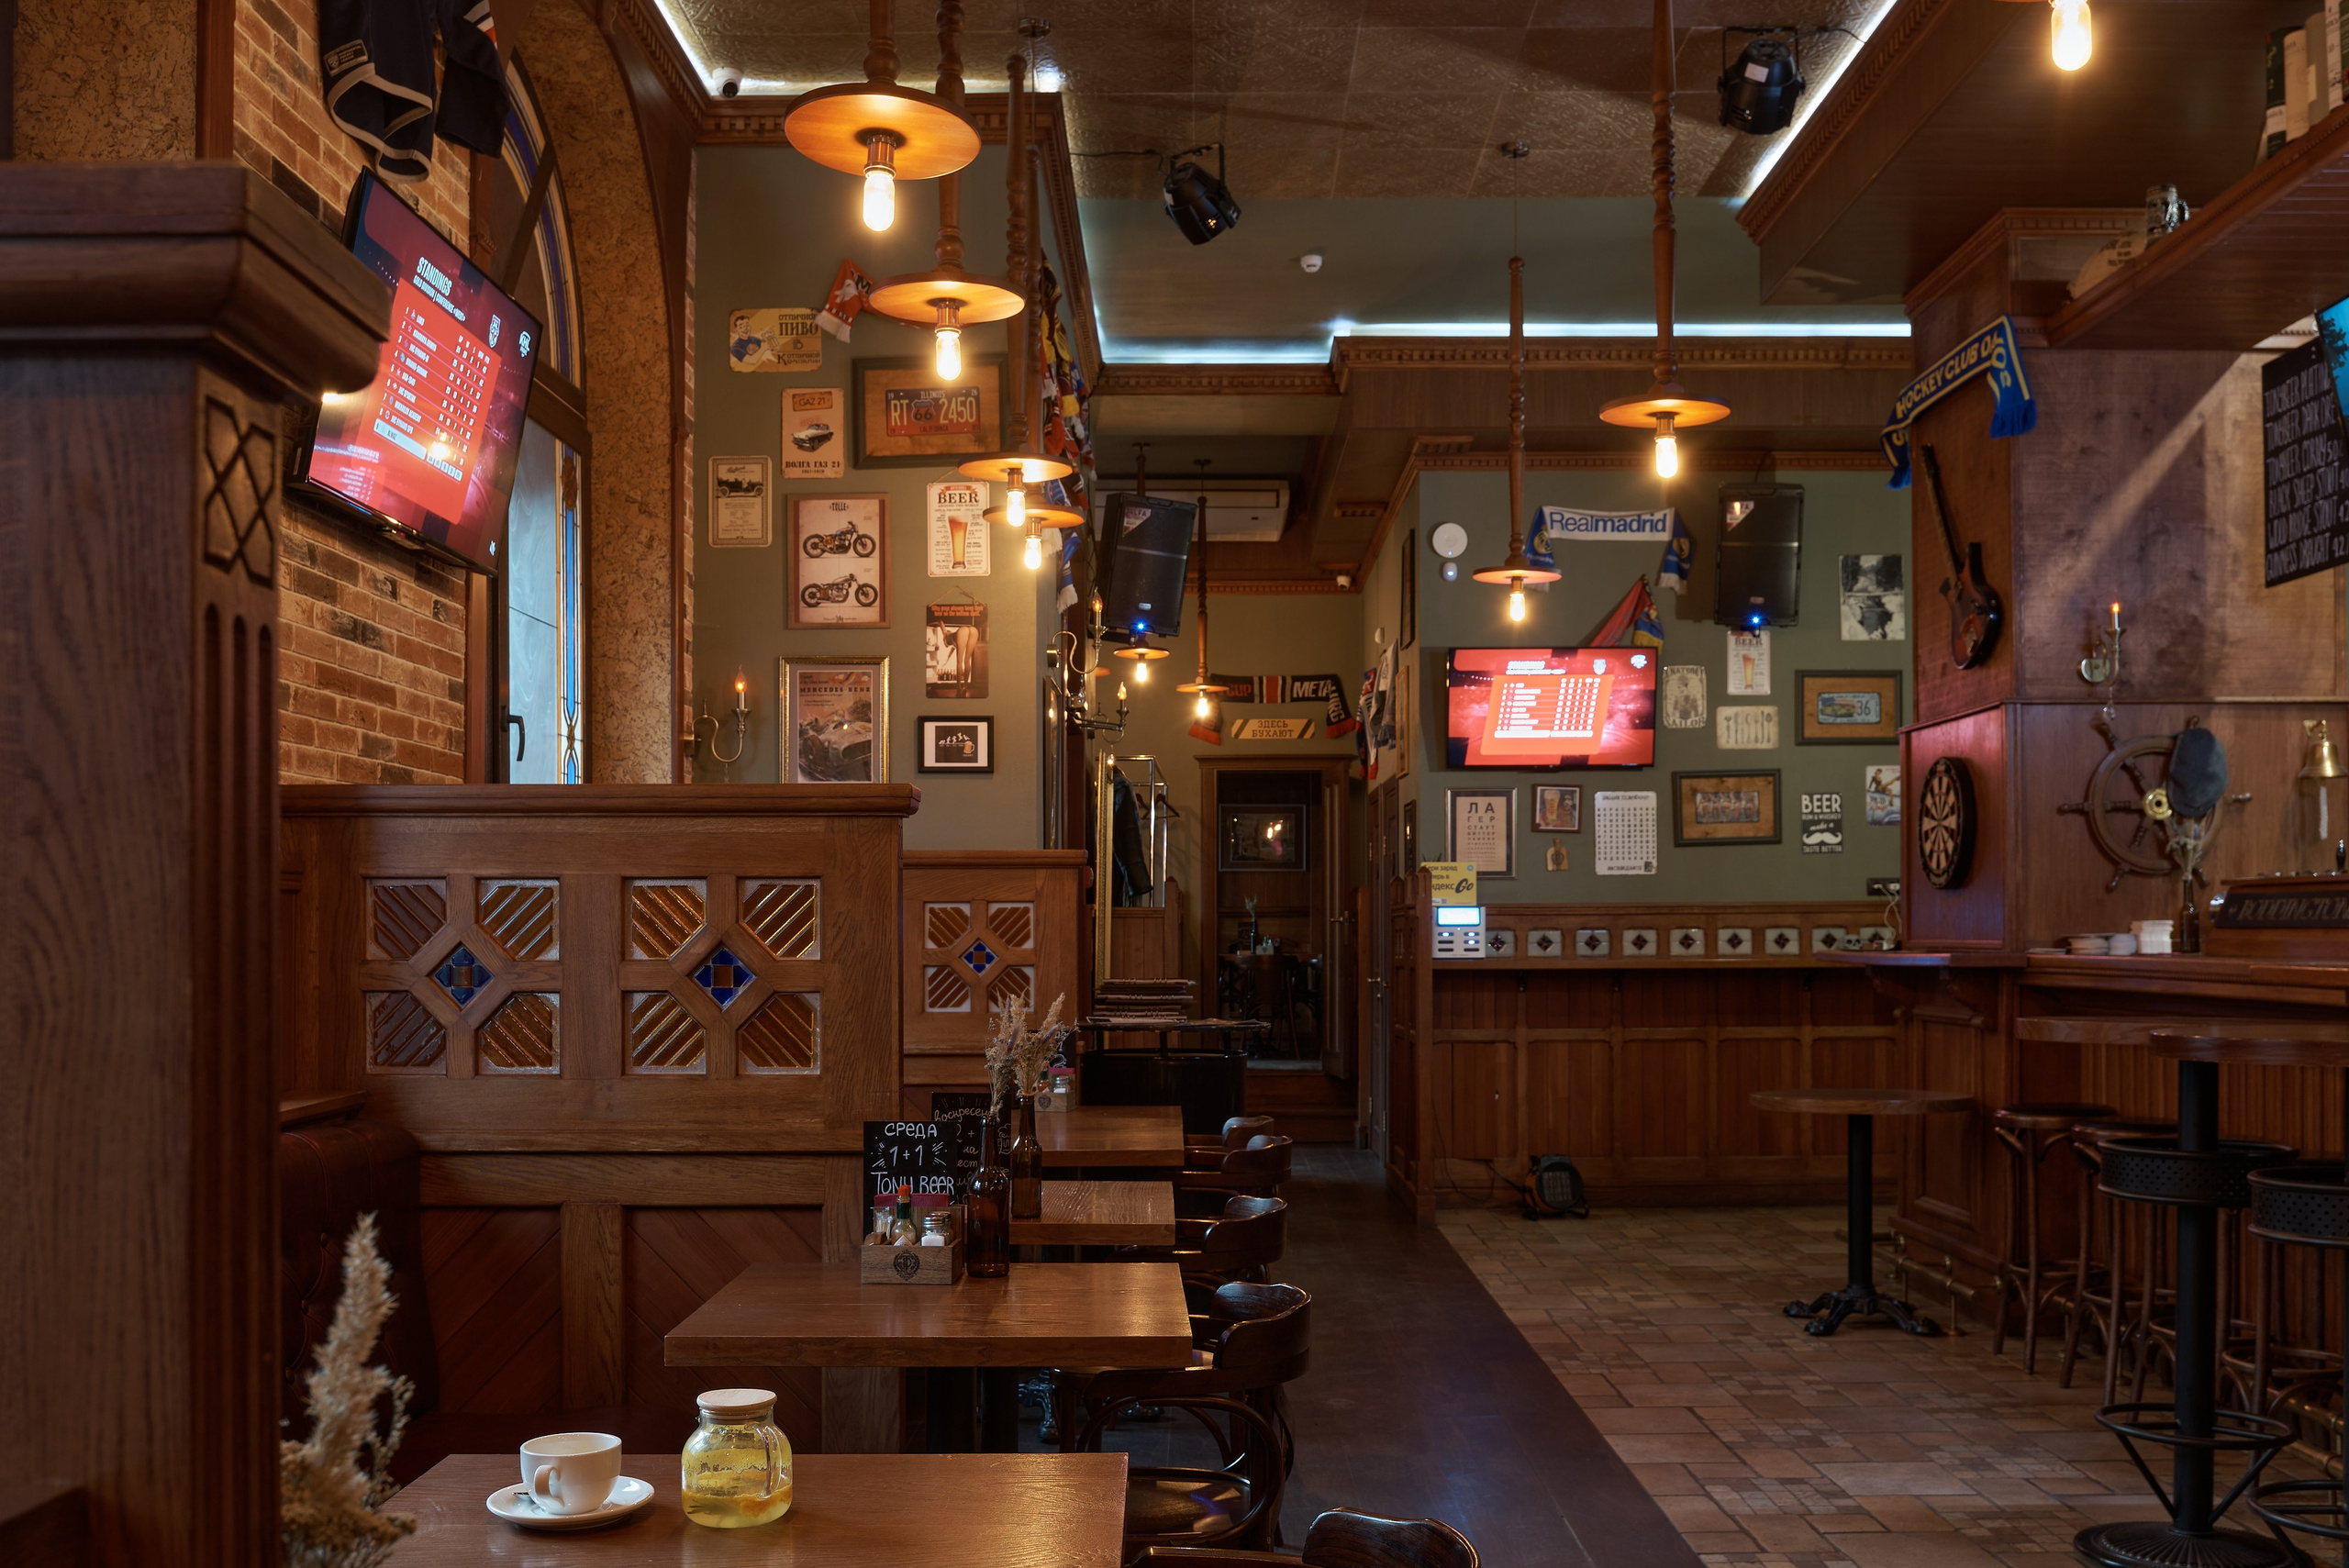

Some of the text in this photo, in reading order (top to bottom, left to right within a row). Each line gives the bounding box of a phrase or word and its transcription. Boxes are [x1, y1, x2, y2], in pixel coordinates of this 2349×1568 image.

[417, 257, 452, 295] STANDINGS
[779, 322, 818, 336] ПИВО
[1897, 371, 1944, 419] HOCKEY
[1944, 342, 1979, 380] CLUB
[798, 396, 827, 406] GAZ 21
[890, 397, 976, 426] RT 66 2450
[2315, 462, 2339, 500] STOUT
[938, 493, 979, 504] BEER
[831, 503, 847, 511] TOLLE
[2312, 495, 2338, 533] STOUT
[1734, 638, 1763, 646] BEER
[1857, 700, 1871, 716] 36
[1258, 720, 1288, 728] ЗДЕСЬ
[1664, 717, 1706, 728] SAILOR
[1252, 729, 1294, 738] БУХАЮТ
[1801, 795, 1841, 813] BEER
[1455, 878, 1474, 894] Go
[885, 1122, 938, 1139] СРЕДА
[919, 1175, 955, 1195] BEER
